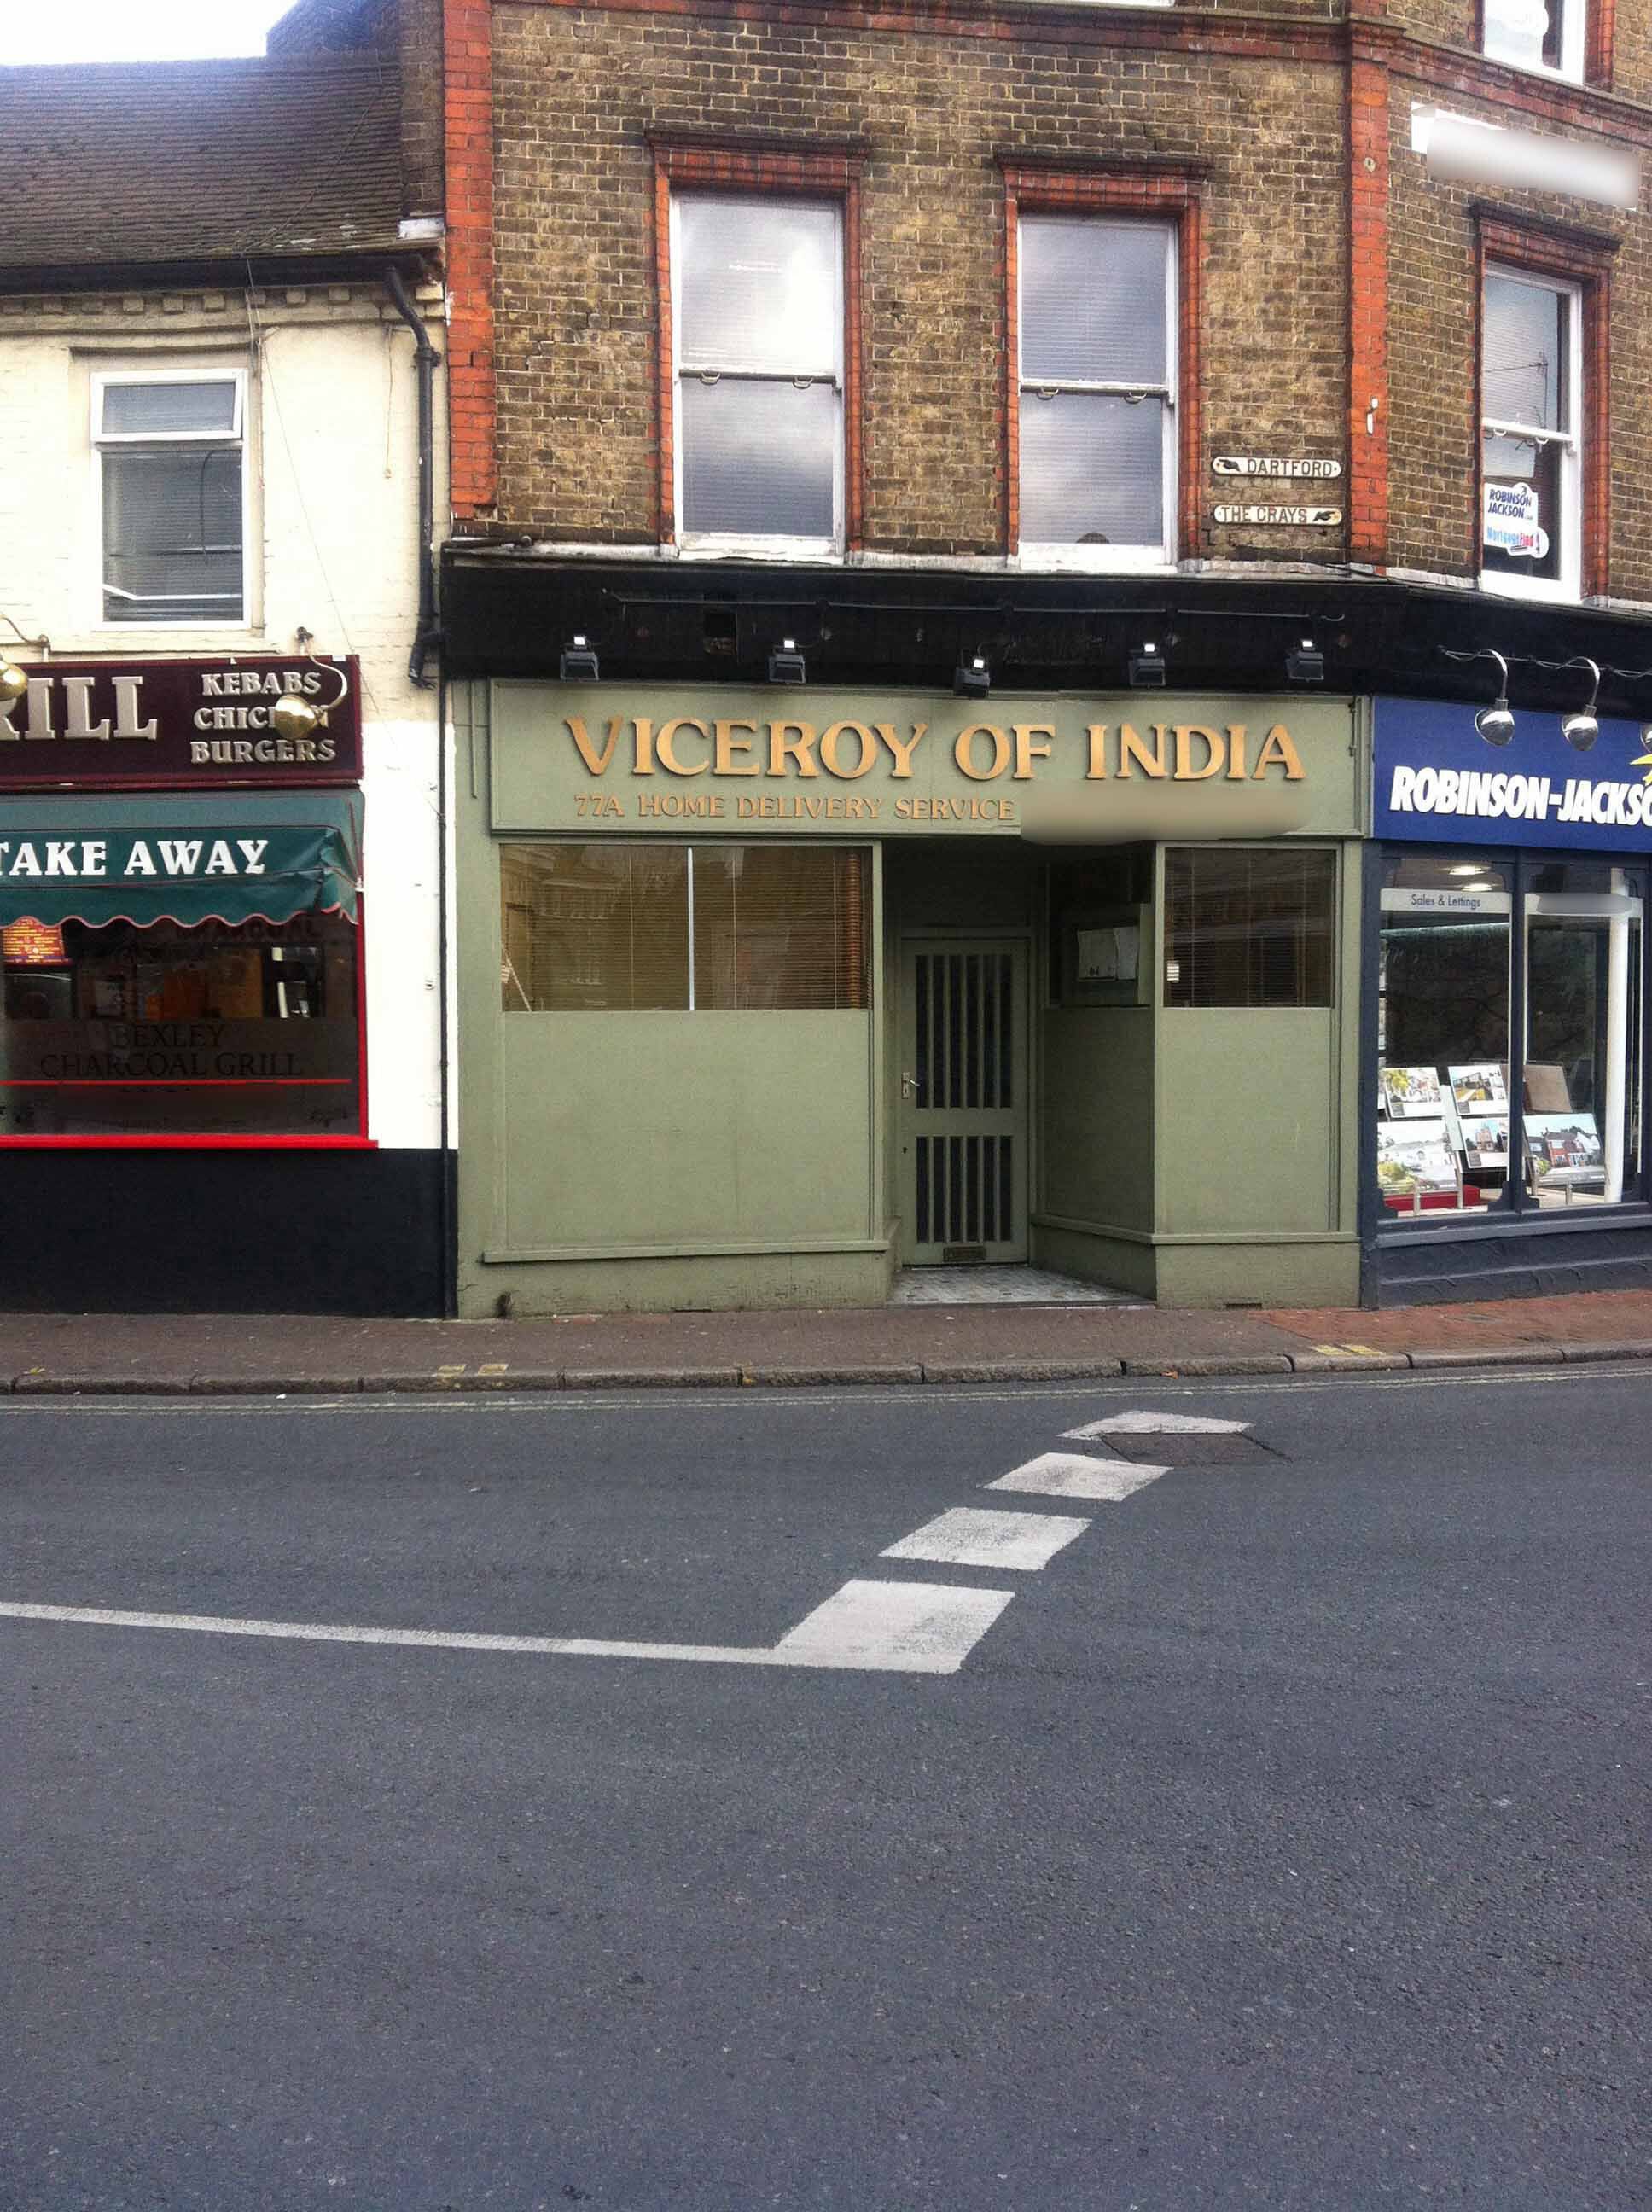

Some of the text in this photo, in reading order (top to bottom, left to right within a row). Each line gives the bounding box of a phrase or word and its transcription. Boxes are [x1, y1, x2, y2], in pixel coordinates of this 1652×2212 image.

[1247, 458, 1333, 477] DARTFORD
[1489, 488, 1532, 507] ROBINSON
[1221, 506, 1308, 524] THE CRAYS
[1487, 503, 1525, 519] JACKSON
[201, 671, 322, 696] KEBABS
[193, 704, 329, 731] CHICN
[189, 739, 337, 764] BURGERS
[566, 716, 1307, 780] VICEROY OF INDIA
[573, 794, 1015, 821] 77A HOME DELIVERY SERVICE
[124, 840, 268, 876] AWAY
[1411, 894, 1481, 911] Sales & Lettings
[113, 1024, 225, 1049] BEXLEY
[39, 1053, 304, 1078] CHARCOAL GRILL
